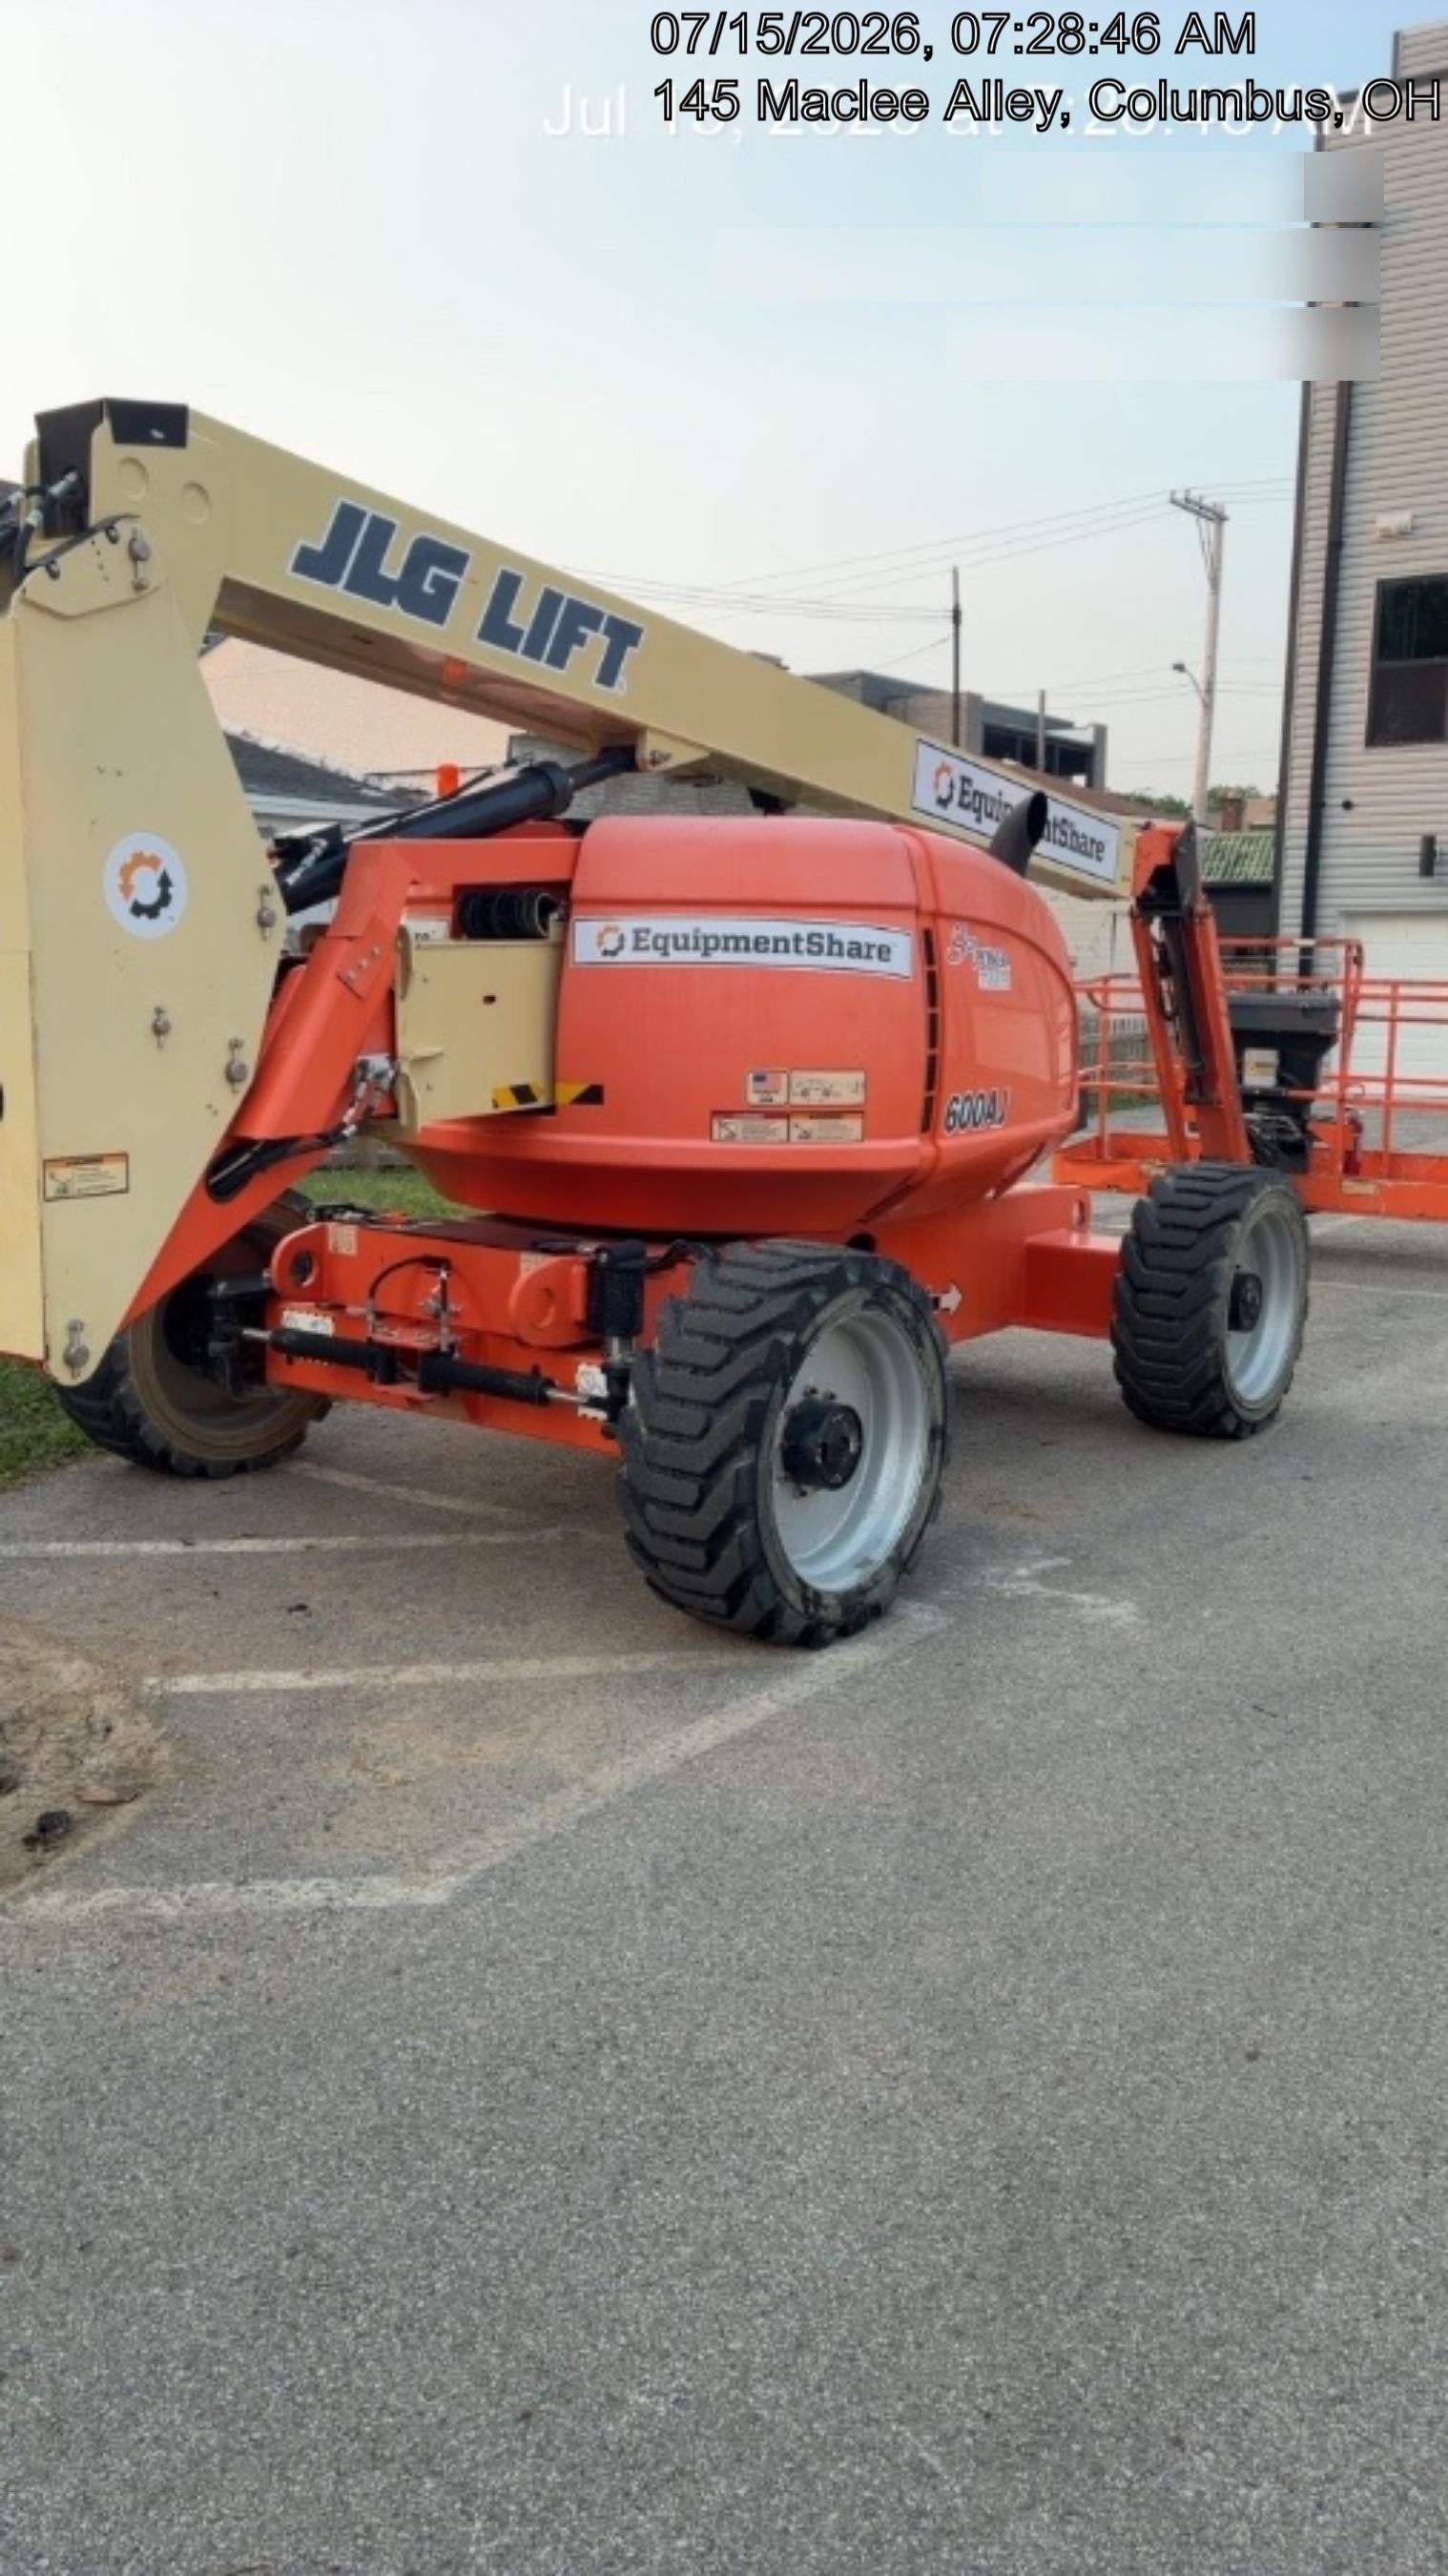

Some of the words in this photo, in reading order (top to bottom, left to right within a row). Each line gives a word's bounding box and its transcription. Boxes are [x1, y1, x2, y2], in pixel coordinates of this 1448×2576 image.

[290, 498, 472, 631] JLG
[475, 566, 645, 693] LIFT
[958, 775, 1106, 862] EquintShare
[631, 927, 892, 963] EquipmentShare
[943, 1088, 1011, 1135] 600AJ
